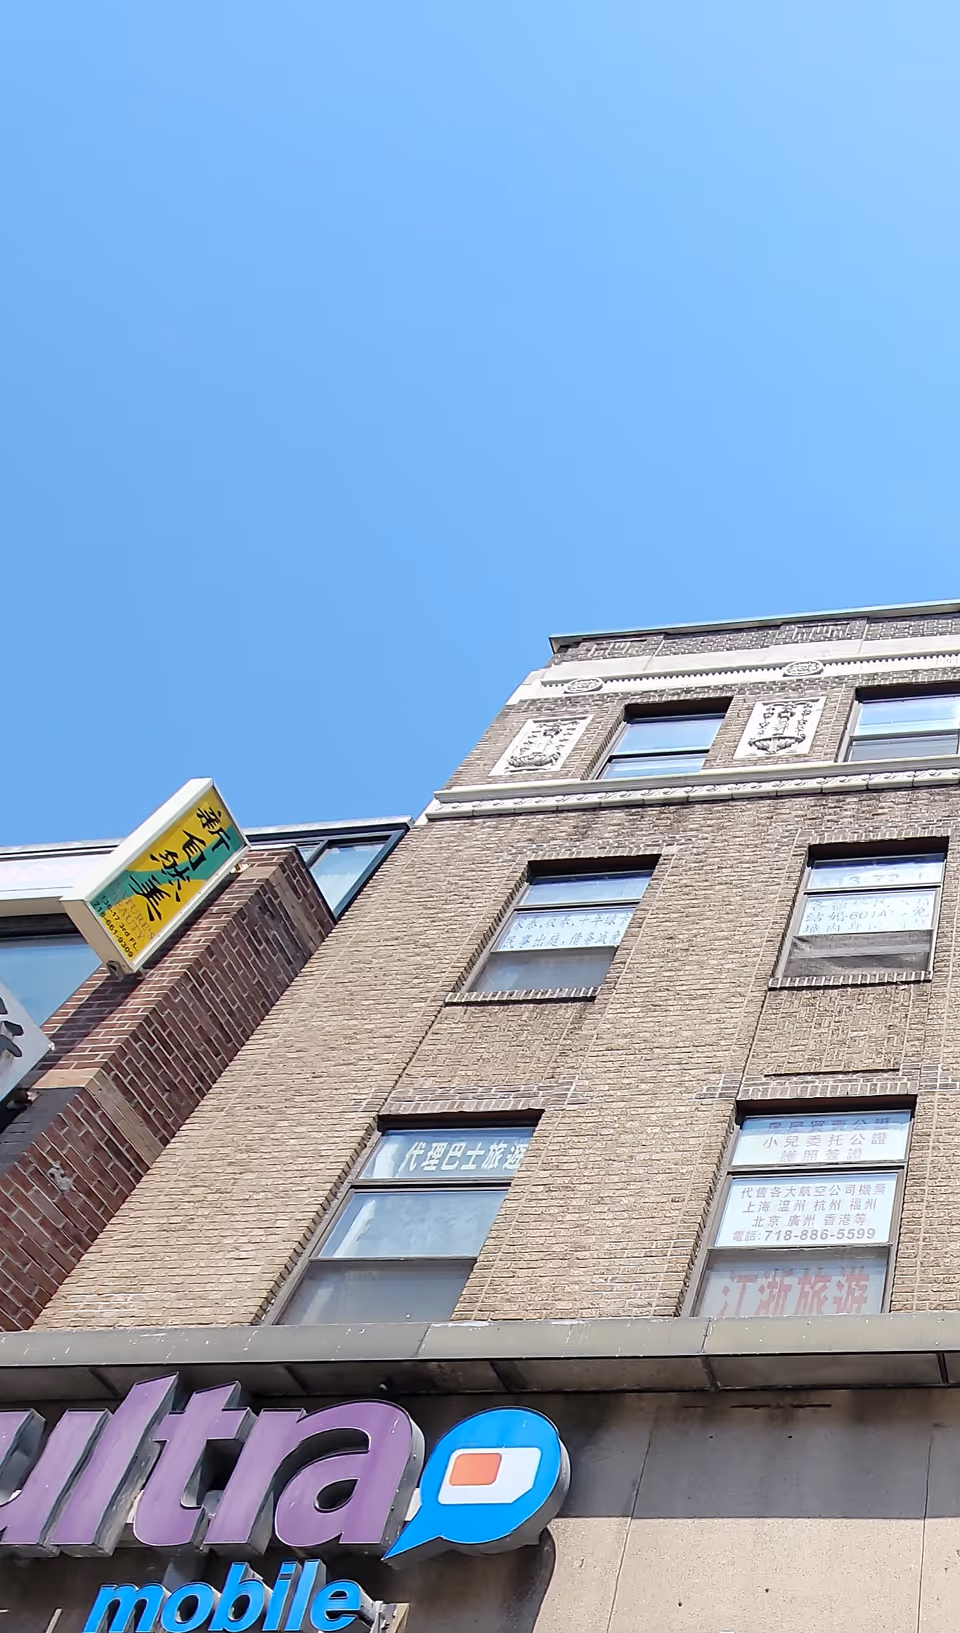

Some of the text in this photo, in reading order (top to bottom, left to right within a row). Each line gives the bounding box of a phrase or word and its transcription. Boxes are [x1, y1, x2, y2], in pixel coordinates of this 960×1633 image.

[128, 807, 231, 922] 新自然美
[0, 1374, 414, 1547] ultra
[82, 1559, 363, 1633] mobile
